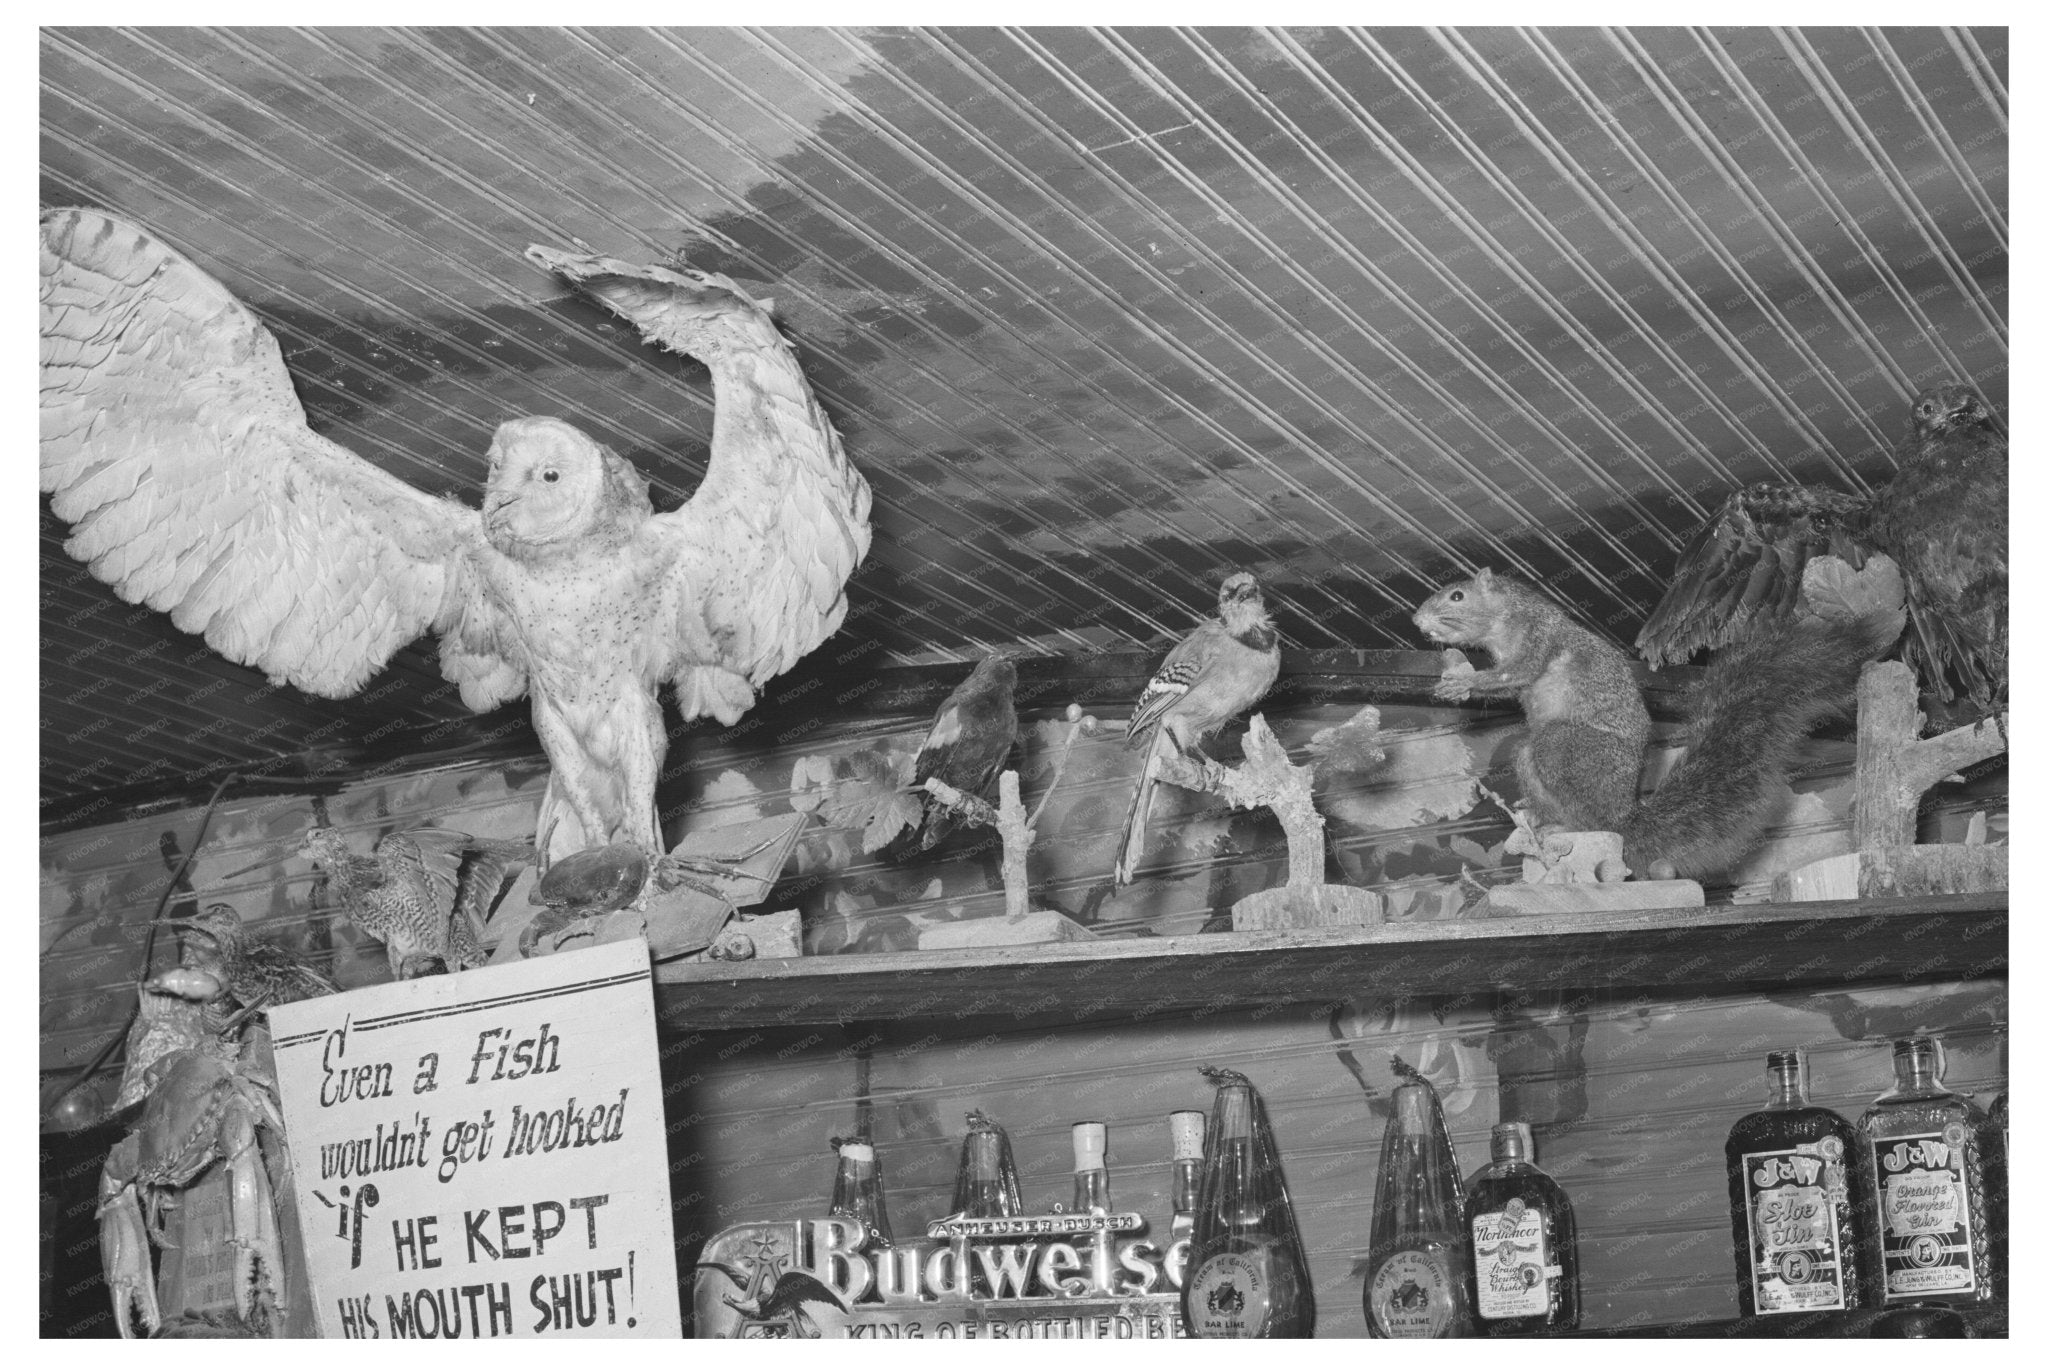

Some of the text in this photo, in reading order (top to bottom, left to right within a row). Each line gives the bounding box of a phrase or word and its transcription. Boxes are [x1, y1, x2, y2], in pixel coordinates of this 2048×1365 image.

[320, 1013, 560, 1107] Even a Fish
[320, 1088, 629, 1183] wouldn't get hooked
[1884, 1140, 1949, 1171] J&W
[1754, 1156, 1821, 1187] J&W
[1890, 1196, 1955, 1214] Flavored
[1897, 1185, 1947, 1200] Orange
[1763, 1199, 1818, 1224] Sloe
[1906, 1213, 1943, 1229] Gin
[392, 1216, 441, 1271] HE
[464, 1194, 609, 1263] KEPT
[338, 1250, 637, 1338] HIS MOUTH SHUT!
[845, 1322, 924, 1338] KING
[936, 1321, 977, 1338] OF
